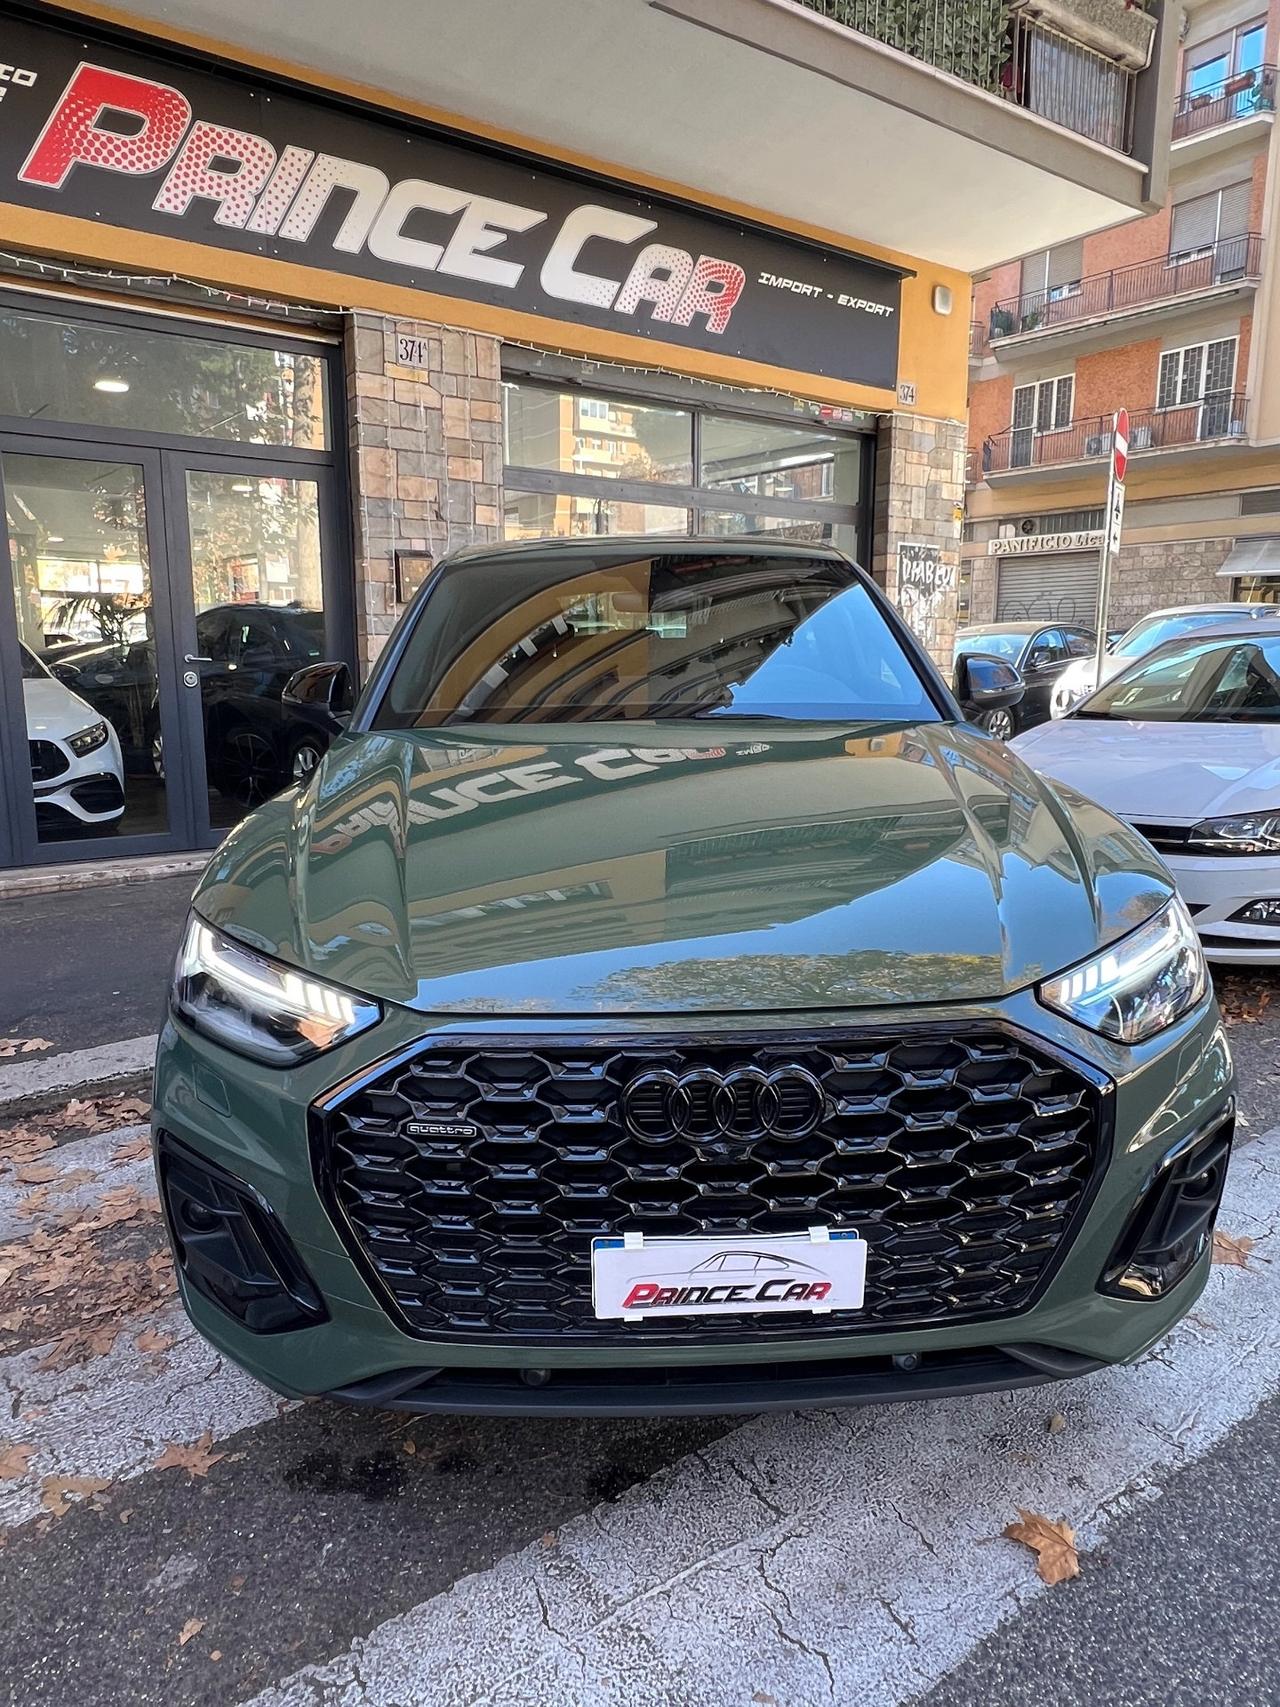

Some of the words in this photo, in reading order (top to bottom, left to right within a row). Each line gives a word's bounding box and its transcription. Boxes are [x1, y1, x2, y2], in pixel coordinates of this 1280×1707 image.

[17, 61, 547, 288] PRINCE
[539, 203, 747, 334] CAR
[757, 271, 823, 298] IMPORT
[837, 293, 895, 317] EXPORT
[899, 384, 914, 403] 374
[991, 535, 1072, 554] PANIFICIO
[409, 1125, 473, 1135] quattro
[622, 1283, 756, 1309] PRINCE
[755, 1278, 832, 1302] CAR
